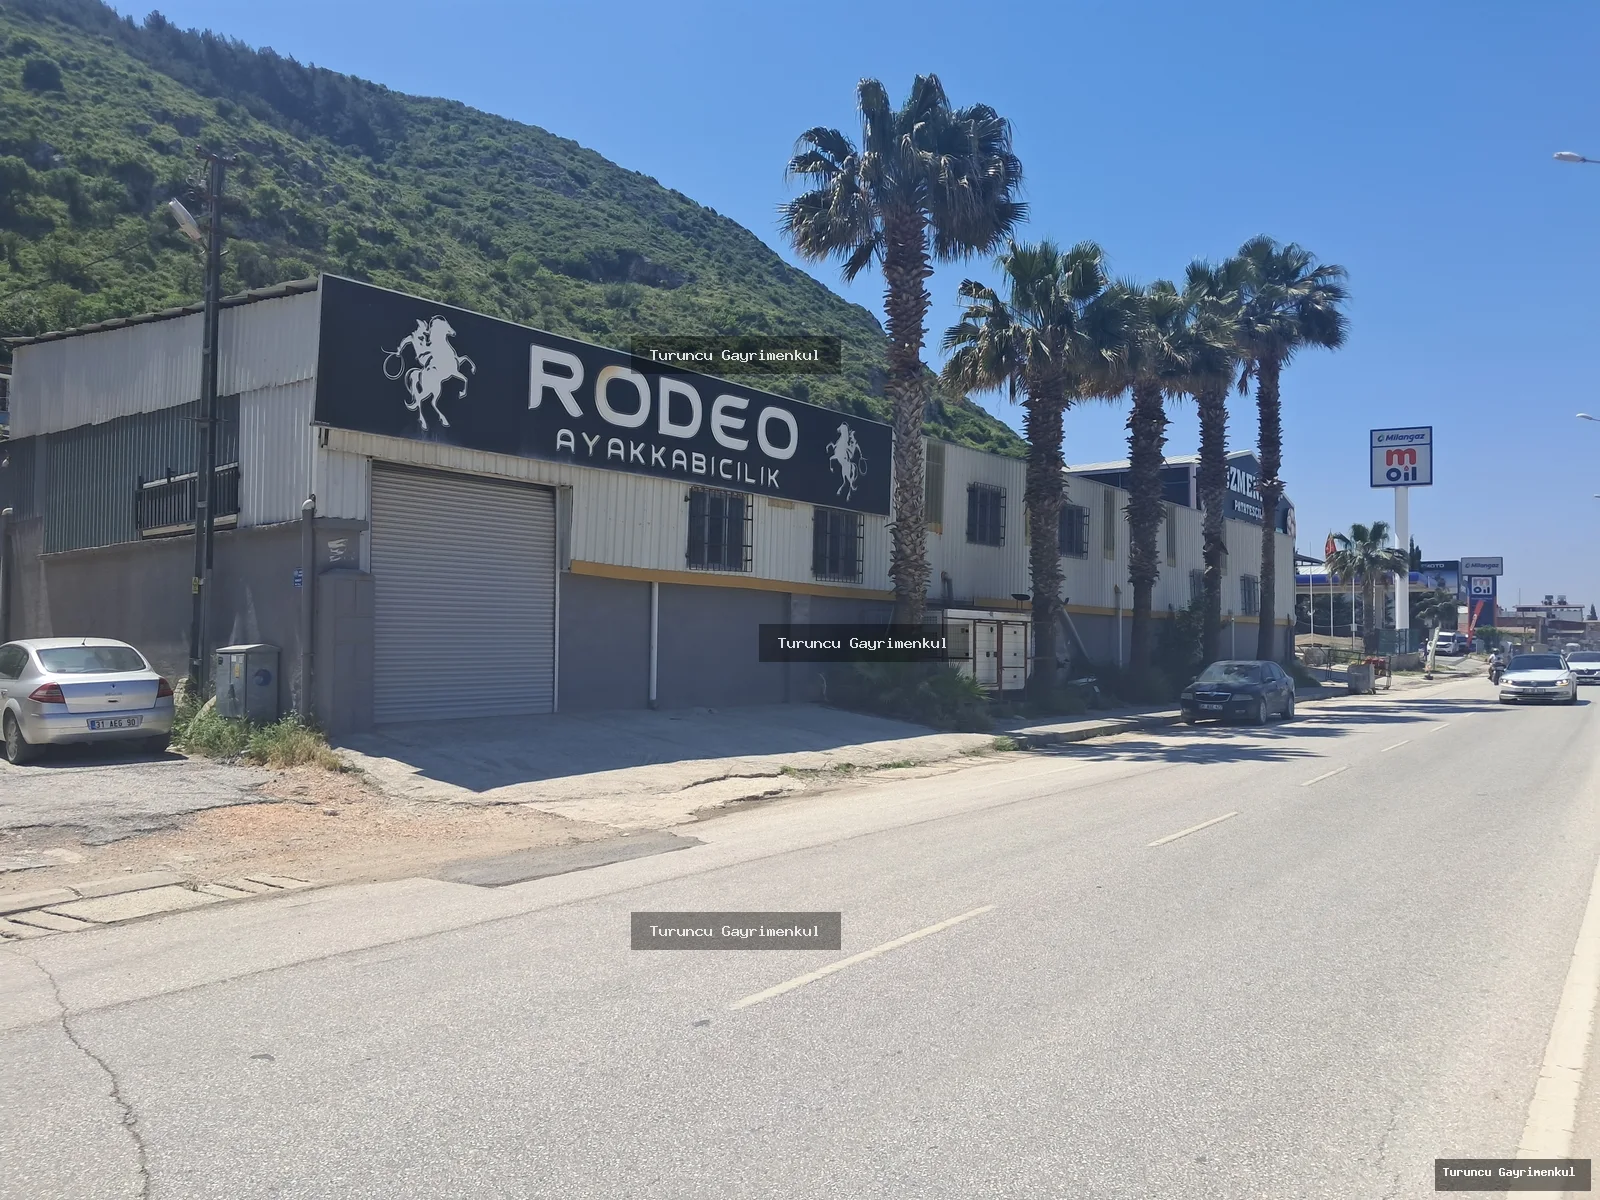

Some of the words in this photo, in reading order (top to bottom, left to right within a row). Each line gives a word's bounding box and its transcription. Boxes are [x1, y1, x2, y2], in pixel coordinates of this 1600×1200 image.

[528, 342, 799, 460] RODEO
[1385, 433, 1426, 443] Milangaz
[556, 428, 780, 489] AYAKKABICILIK
[1470, 562, 1500, 570] Milangaz
[96, 721, 105, 729] 31
